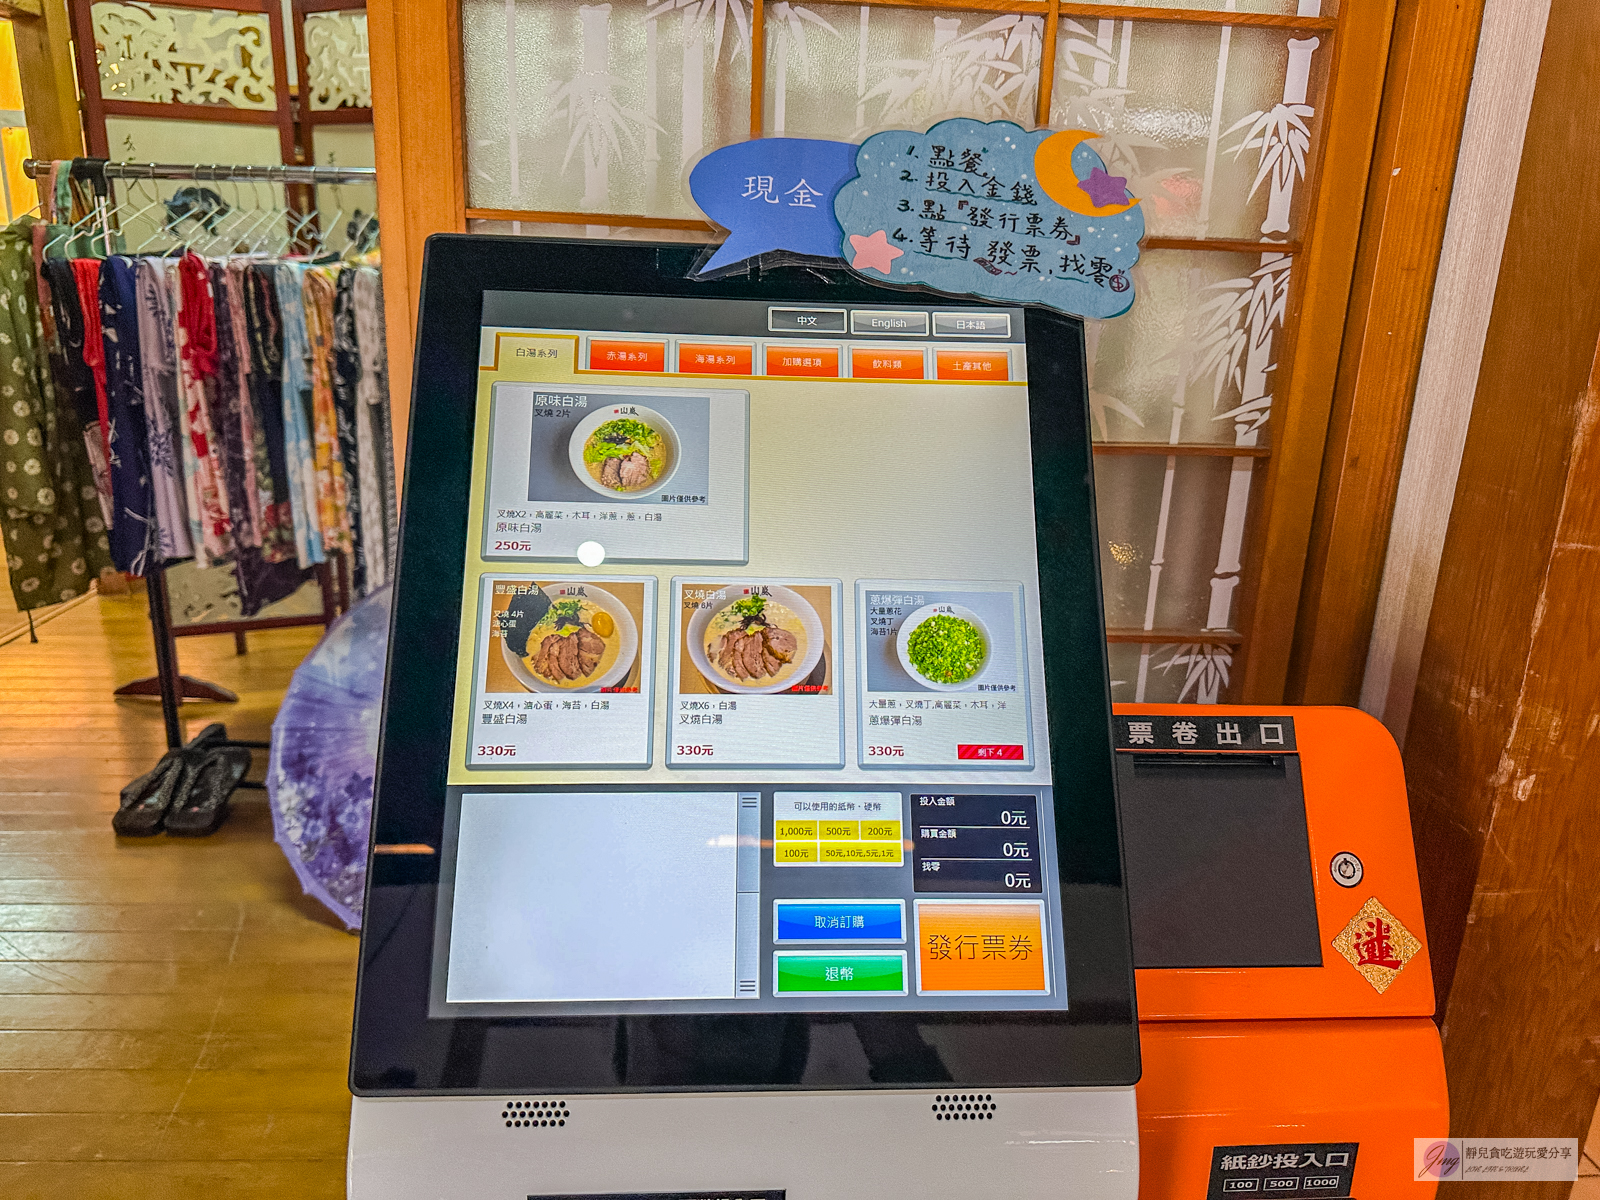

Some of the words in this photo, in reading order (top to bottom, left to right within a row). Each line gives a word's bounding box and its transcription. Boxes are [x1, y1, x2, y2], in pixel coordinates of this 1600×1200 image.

[740, 175, 823, 208] 現金
[797, 316, 817, 326] 中文
[871, 318, 907, 329] English
[956, 320, 986, 330] 日本語
[516, 347, 558, 359] 白湯系列
[606, 351, 648, 362] 赤湯系列
[695, 354, 736, 365] 海湯系列
[782, 356, 822, 367] 加購選項
[872, 359, 902, 369] 飲料類
[952, 361, 992, 372] 土產其他
[534, 394, 588, 408] 原味白湯
[495, 522, 542, 533] 原味白湯
[494, 540, 532, 551] 250元
[495, 584, 539, 596] 豐盛白湯
[684, 589, 726, 600] 叉燒白湯
[481, 713, 527, 725] 豐盛白湯
[679, 714, 723, 725] 叉燒白湯
[1127, 721, 1284, 745] 票卷出口
[477, 745, 516, 756] 330元
[676, 745, 714, 756] 330元
[868, 745, 905, 757] 330元
[919, 796, 955, 806] 投入金額
[1000, 810, 1027, 826] 0元
[779, 827, 813, 837] 1,000元
[826, 827, 851, 836] 500元
[867, 826, 893, 836] 200元
[920, 828, 957, 839] 購買金額
[783, 848, 809, 858] 100元
[1002, 842, 1029, 858] 0元
[922, 861, 941, 872] 找零
[1004, 873, 1031, 888] 0元
[814, 915, 865, 929] 取消訂購
[927, 934, 1033, 961] 發行票券
[825, 966, 854, 981] 退幣
[1220, 1151, 1349, 1171] 紙鈔投入口
[1228, 1180, 1253, 1190] 100
[1269, 1179, 1292, 1188] 500
[1305, 1177, 1337, 1187] 1000
